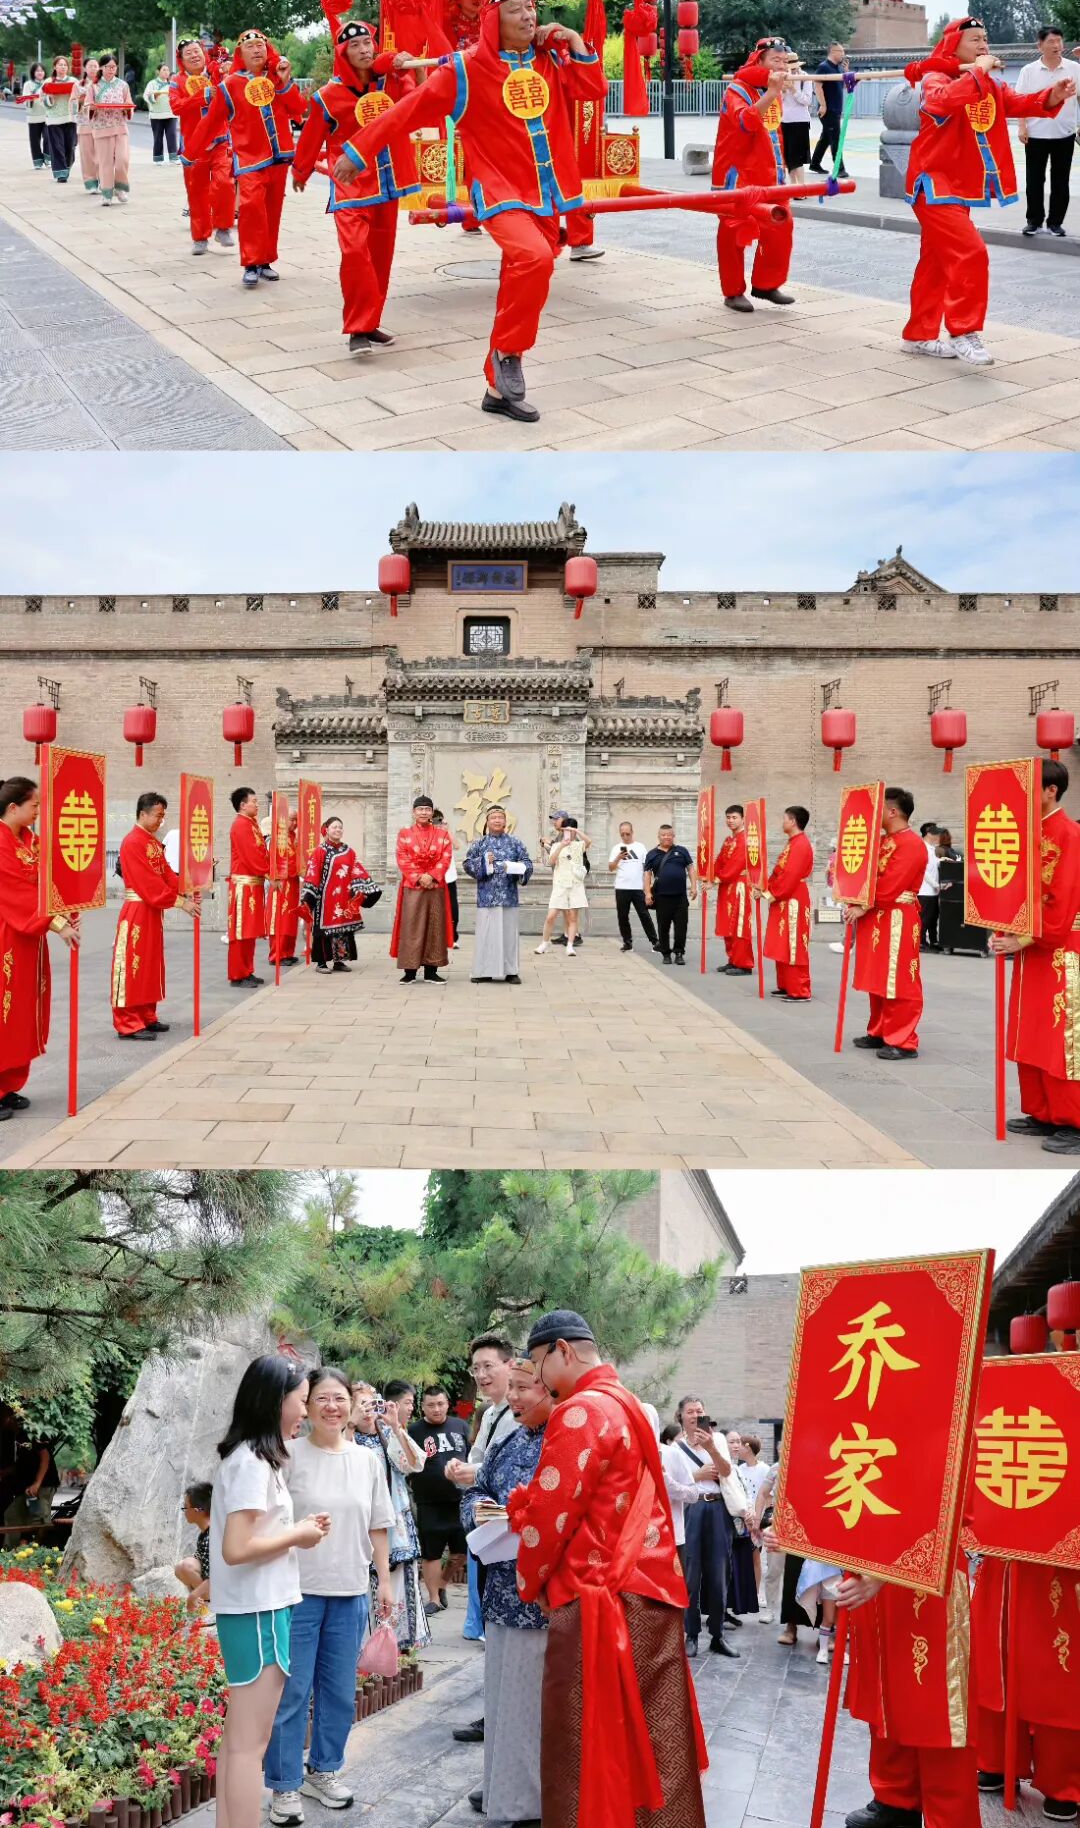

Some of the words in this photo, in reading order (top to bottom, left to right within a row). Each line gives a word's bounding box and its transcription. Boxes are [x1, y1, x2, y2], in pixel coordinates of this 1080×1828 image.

[508, 76, 545, 111] 囍
[59, 789, 98, 872] 囍
[189, 803, 210, 863] 囍
[841, 814, 868, 874] 囍
[974, 802, 1020, 889] 囍
[821, 1301, 921, 1529] 乔家
[974, 1405, 1068, 1510] 囍
